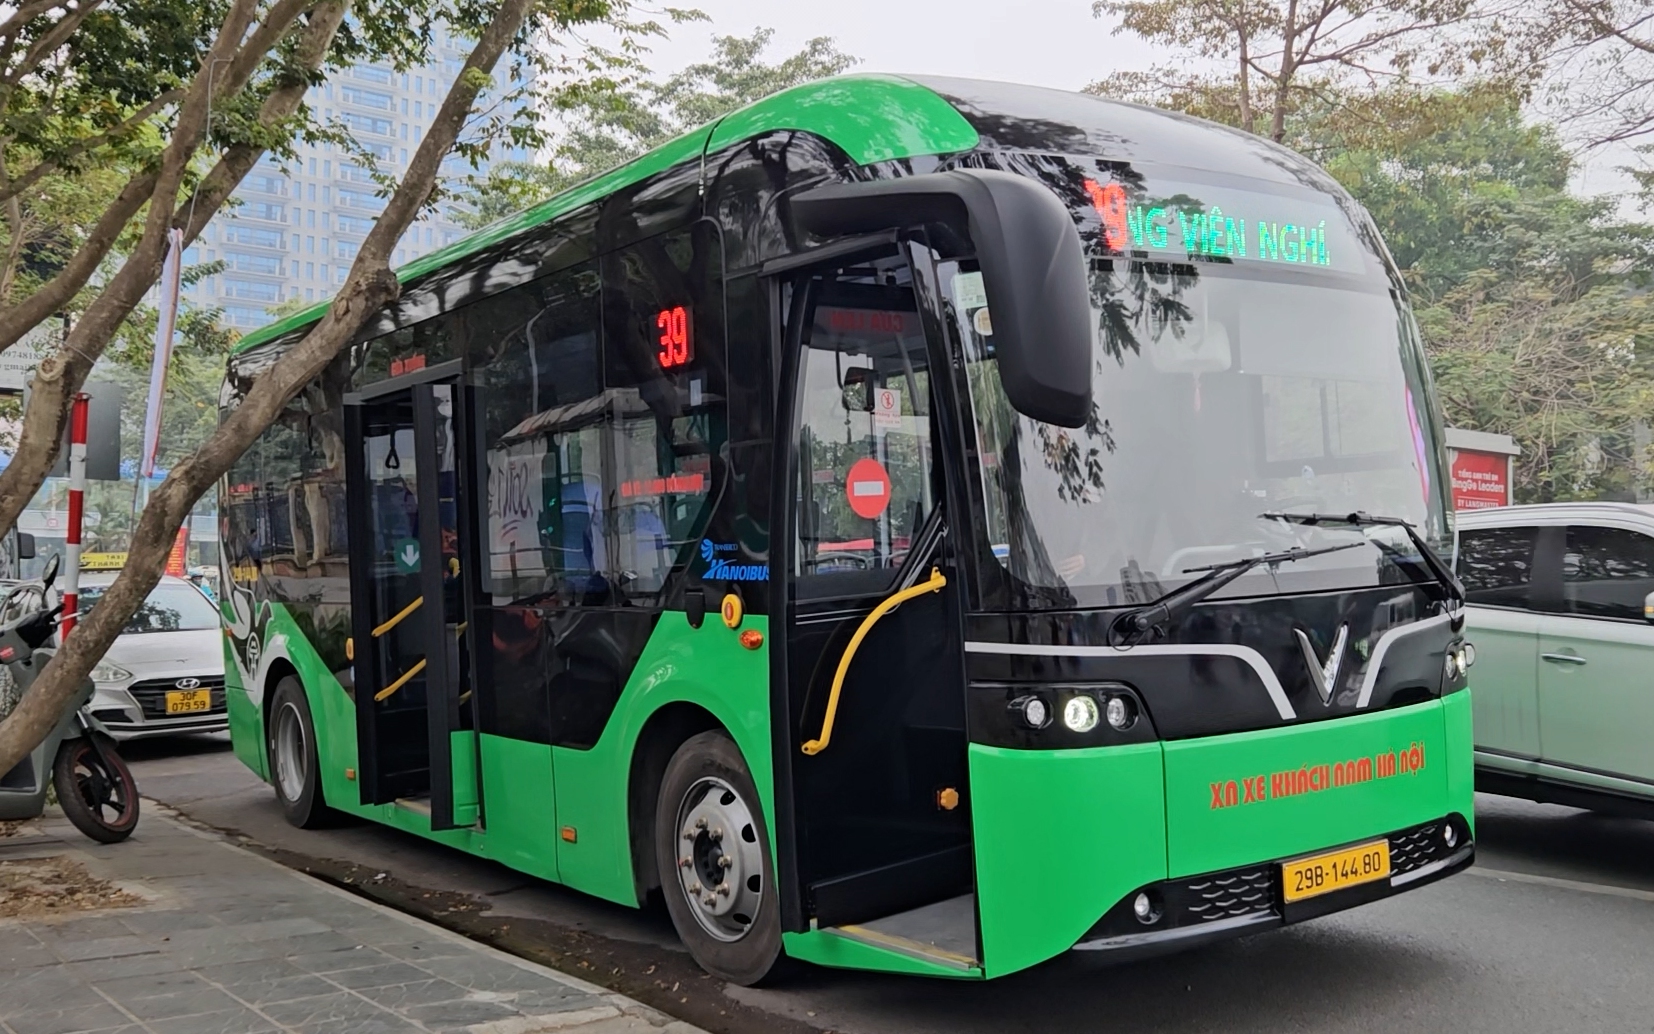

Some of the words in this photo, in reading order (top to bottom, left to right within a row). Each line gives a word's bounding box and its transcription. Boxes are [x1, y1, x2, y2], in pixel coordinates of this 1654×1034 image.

[1179, 206, 1246, 257] VIÊN
[657, 306, 688, 367] 39
[1478, 480, 1504, 493] Leaders
[172, 701, 190, 712] 079
[193, 700, 206, 710] 59
[180, 692, 198, 701] 30F
[1243, 775, 1266, 804] XE
[1271, 763, 1331, 799] KHÁCH
[1333, 757, 1373, 787] NAM
[1294, 851, 1381, 892] 29B-144.80
